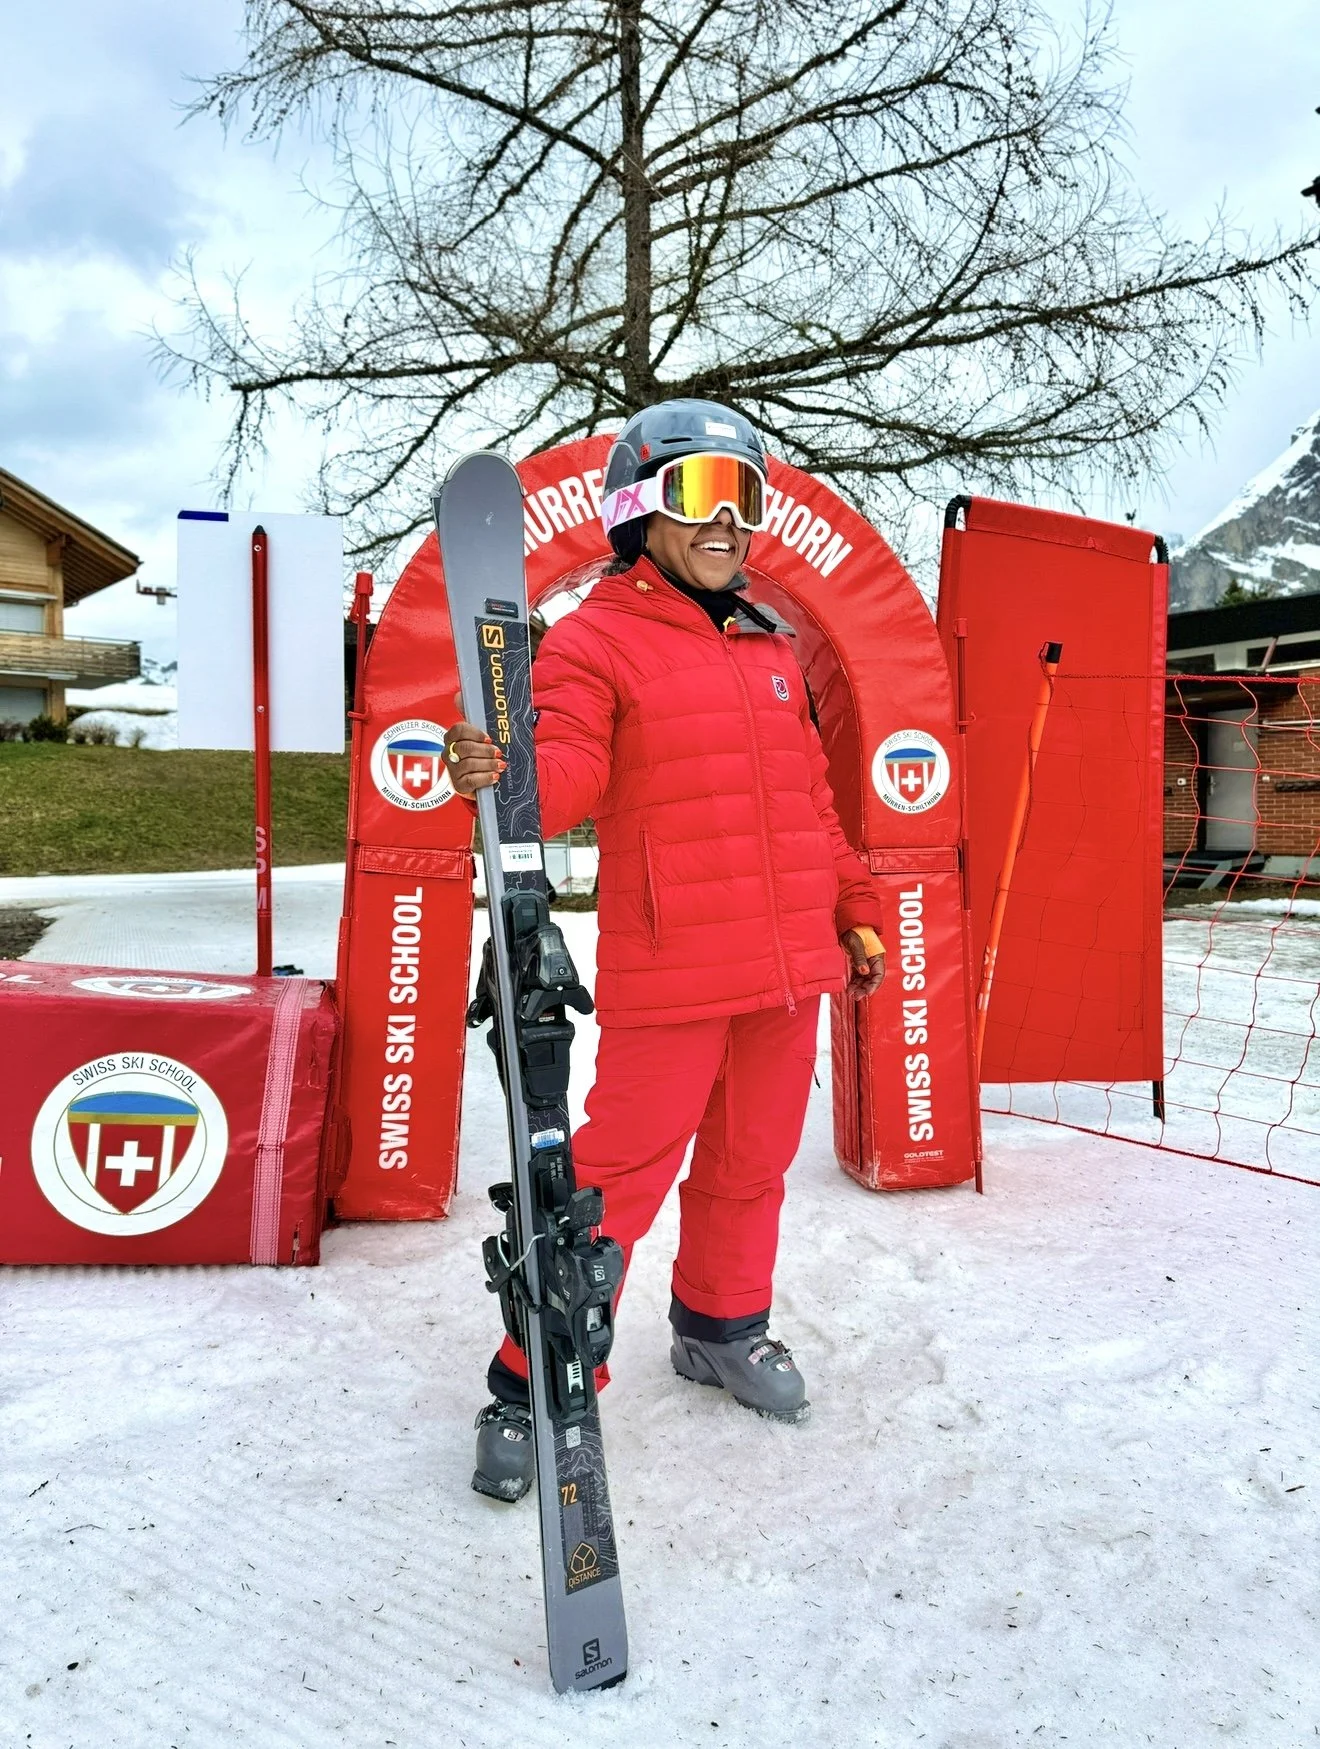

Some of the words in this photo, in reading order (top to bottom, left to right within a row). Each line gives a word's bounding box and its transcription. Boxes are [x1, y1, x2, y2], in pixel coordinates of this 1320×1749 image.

[389, 886, 423, 1004] SCHOOL
[899, 883, 926, 992] SCHOOL
[384, 1015, 417, 1064] SKI
[902, 1000, 928, 1045] SKI
[72, 1058, 117, 1086] SWISS
[121, 1056, 145, 1069] SKI
[149, 1058, 197, 1093] SCHOOL
[904, 1053, 934, 1141] SWISS
[378, 1073, 413, 1170] SWISS
[561, 1483, 578, 1506] 72
[569, 1567, 601, 1588] DISTANCE
